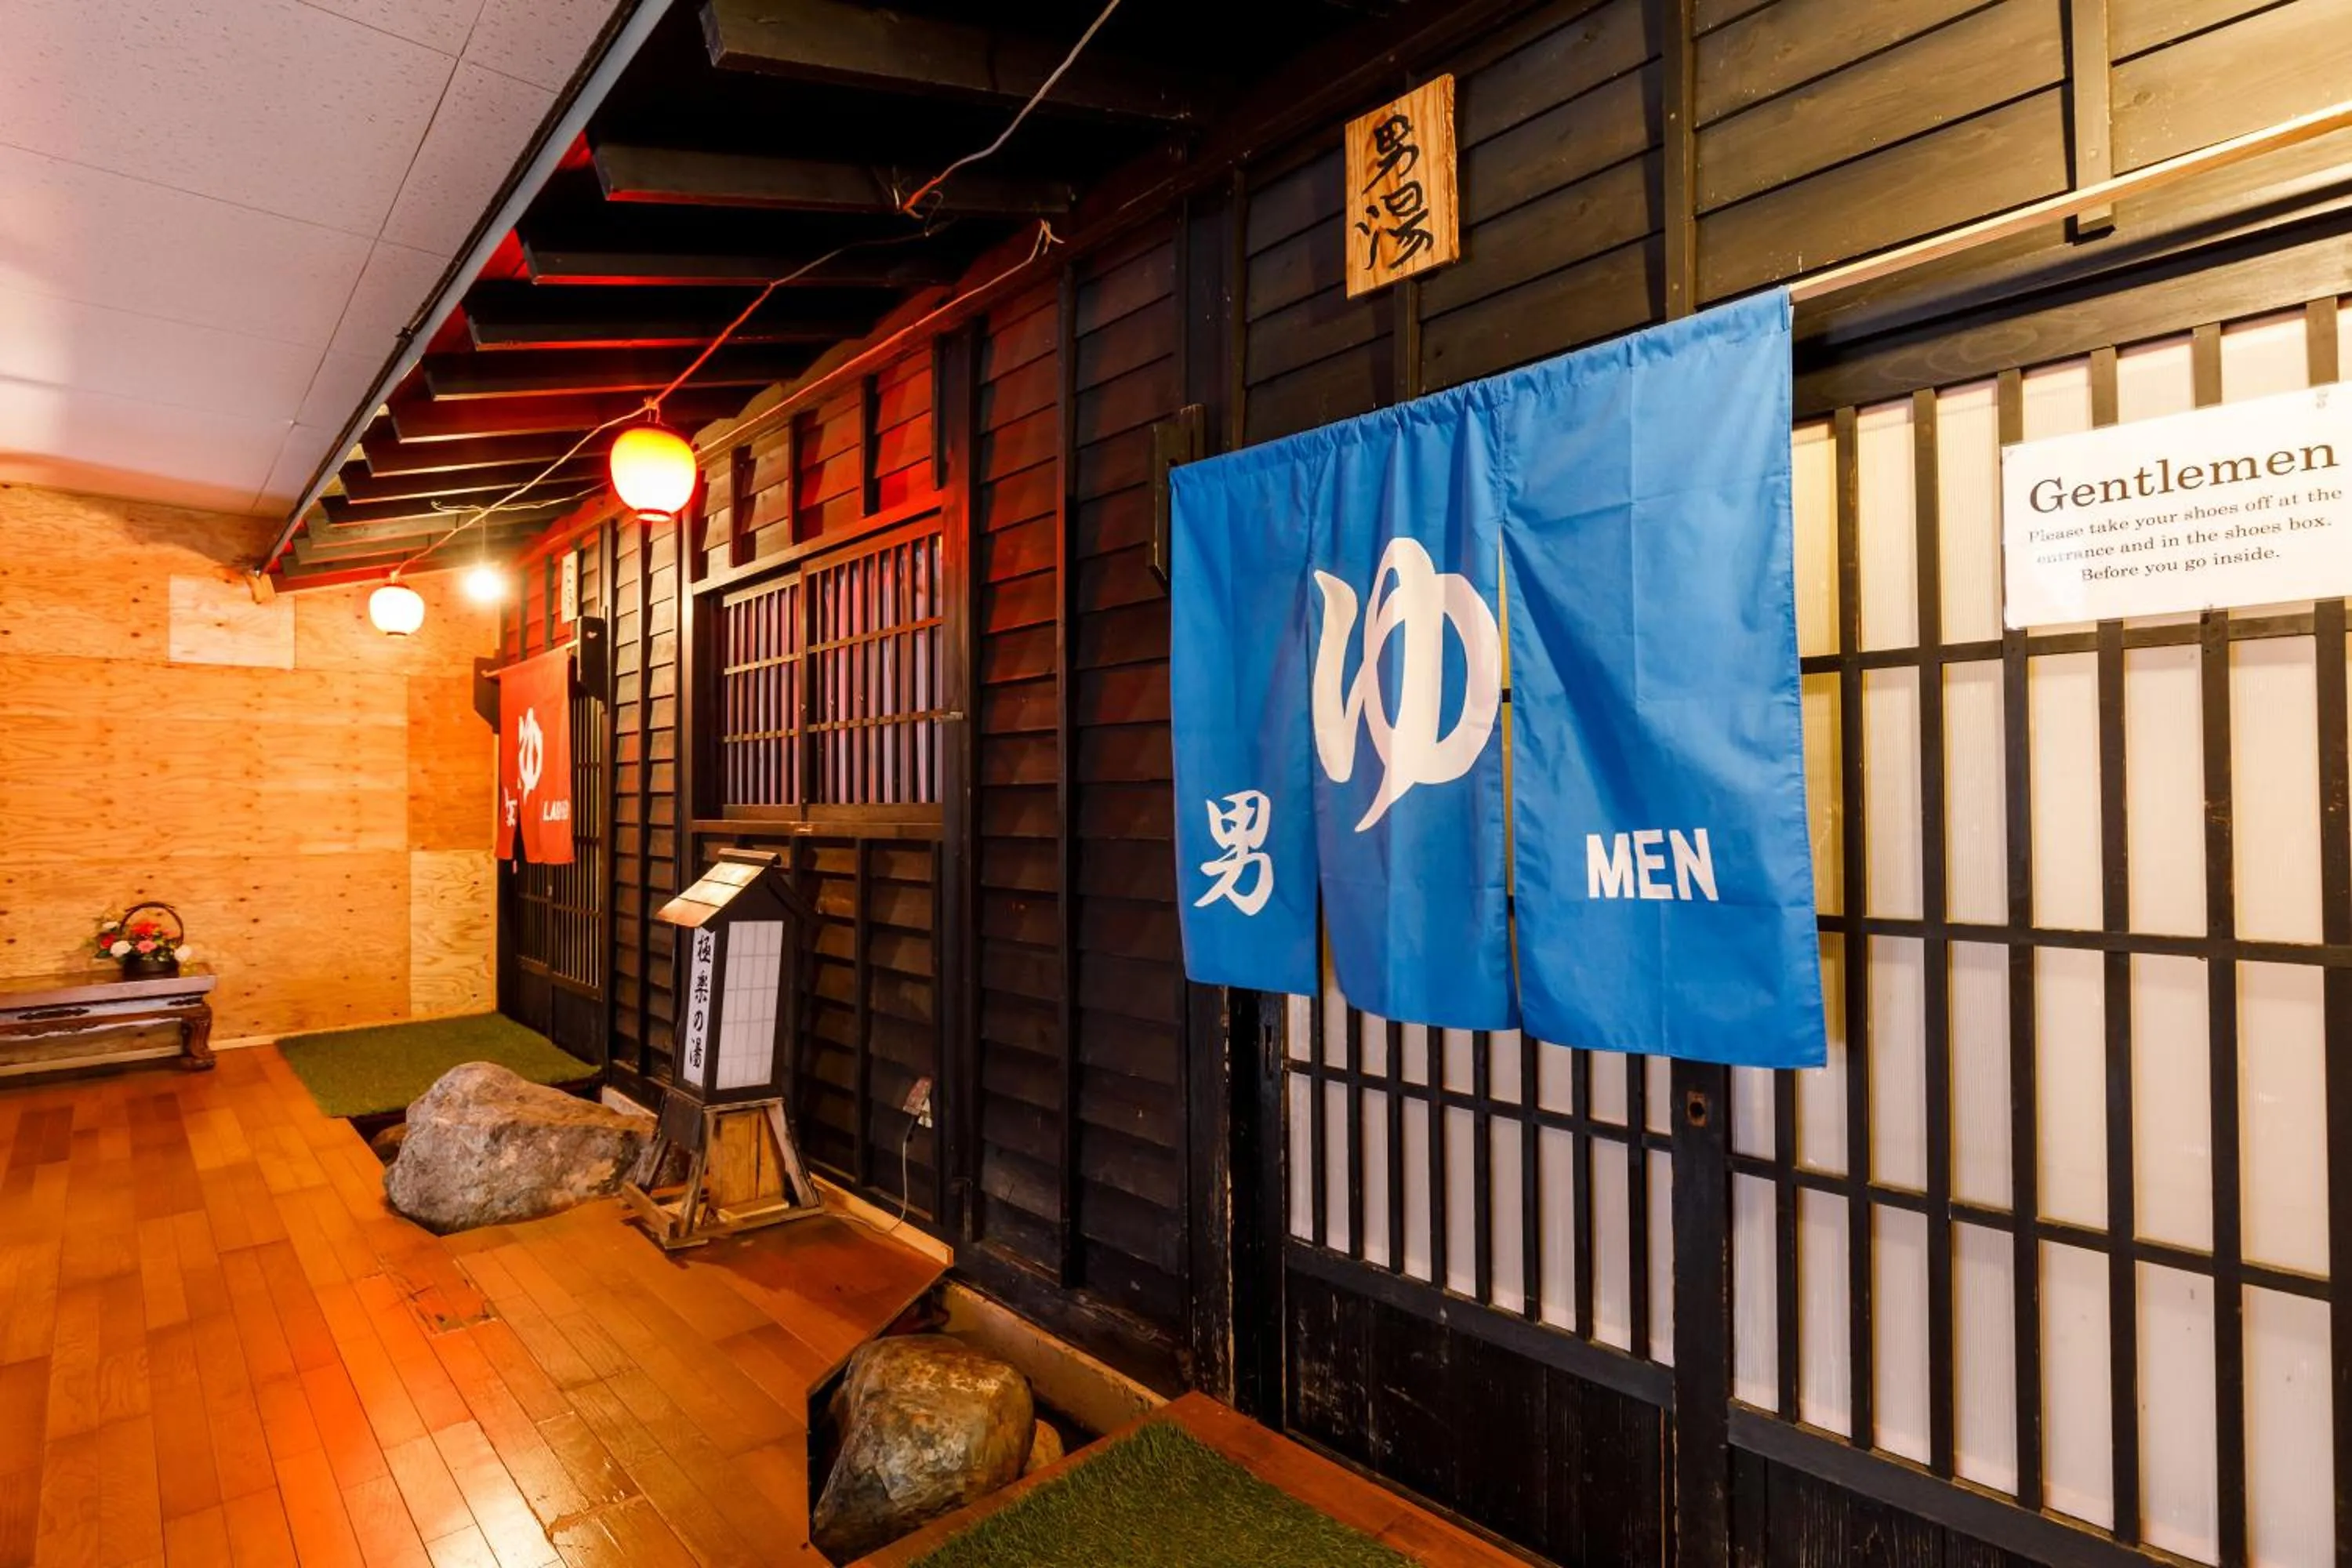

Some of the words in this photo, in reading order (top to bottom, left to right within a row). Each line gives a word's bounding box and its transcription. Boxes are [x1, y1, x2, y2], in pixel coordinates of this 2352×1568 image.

[2029, 444, 2340, 514] Gentlemen
[2028, 526, 2085, 543] Please
[2089, 518, 2129, 535] take
[2134, 513, 2178, 531] your
[2183, 503, 2239, 521] shoes
[2245, 495, 2274, 512] off
[2278, 493, 2299, 507] at
[2307, 488, 2343, 503] the
[2036, 546, 2115, 564] entrance
[2120, 536, 2154, 554] and
[2161, 535, 2180, 549] in
[2187, 530, 2219, 545] the
[2224, 523, 2282, 539] shoes
[2288, 517, 2332, 532] box.
[2081, 565, 2140, 582] Before
[2144, 561, 2178, 577] you
[2184, 557, 2207, 572] go
[2212, 546, 2281, 566] inside.
[1314, 537, 1501, 833] ゆ
[517, 706, 543, 806] ゆ
[1194, 789, 1274, 916] 男
[1586, 828, 1719, 901] MEN
